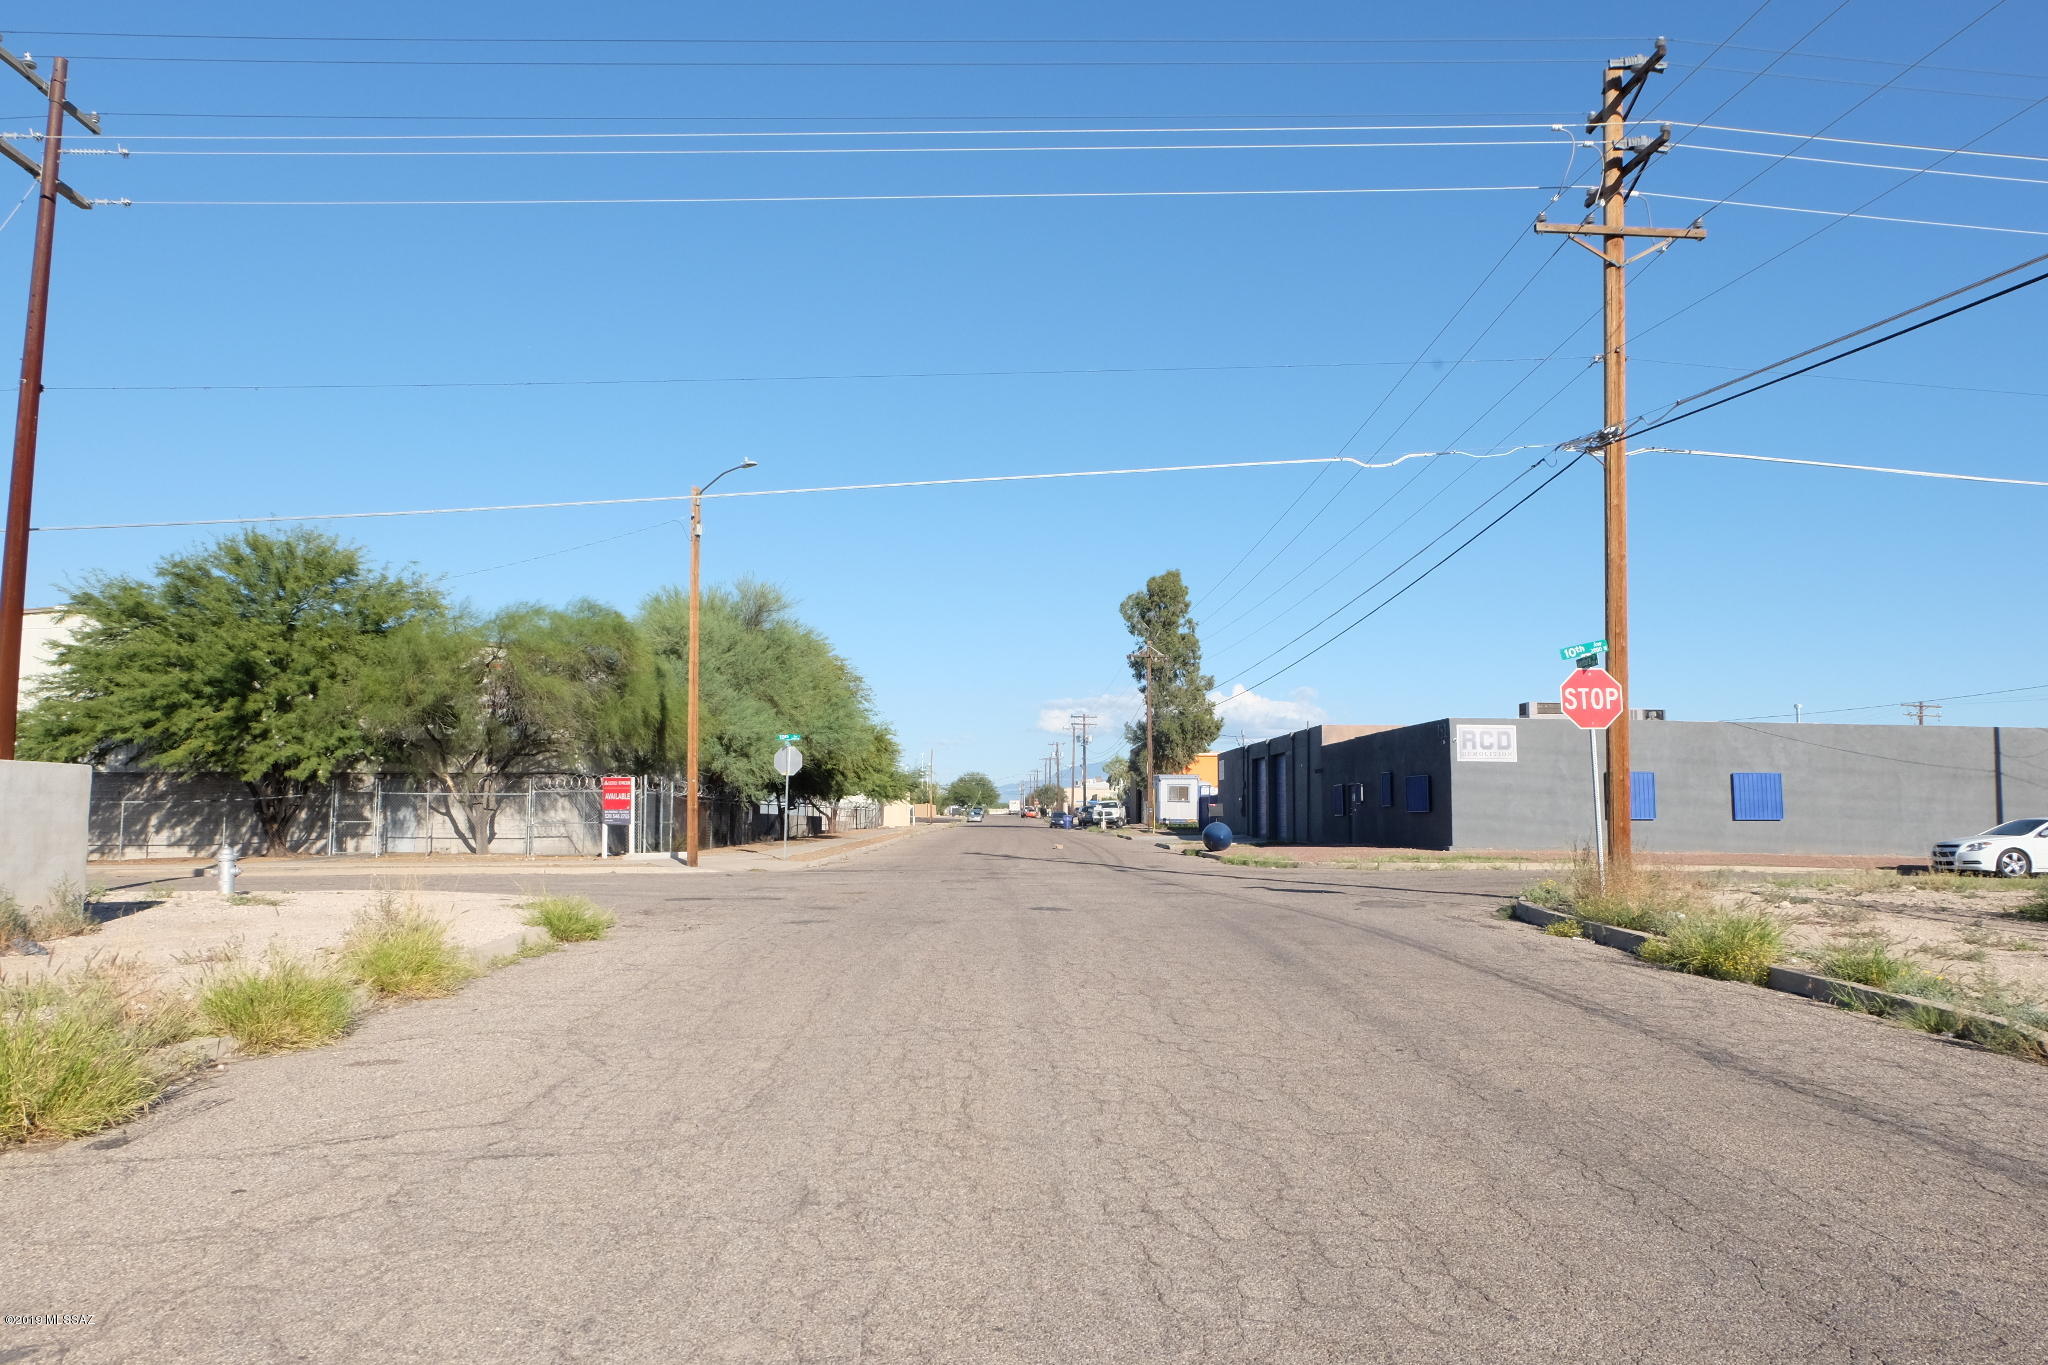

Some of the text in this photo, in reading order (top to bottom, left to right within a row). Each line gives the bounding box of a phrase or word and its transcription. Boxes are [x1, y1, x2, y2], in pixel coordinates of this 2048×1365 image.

[1564, 645, 1585, 658] 10th
[1564, 687, 1619, 710] STOP
[1462, 729, 1512, 751] RCD
